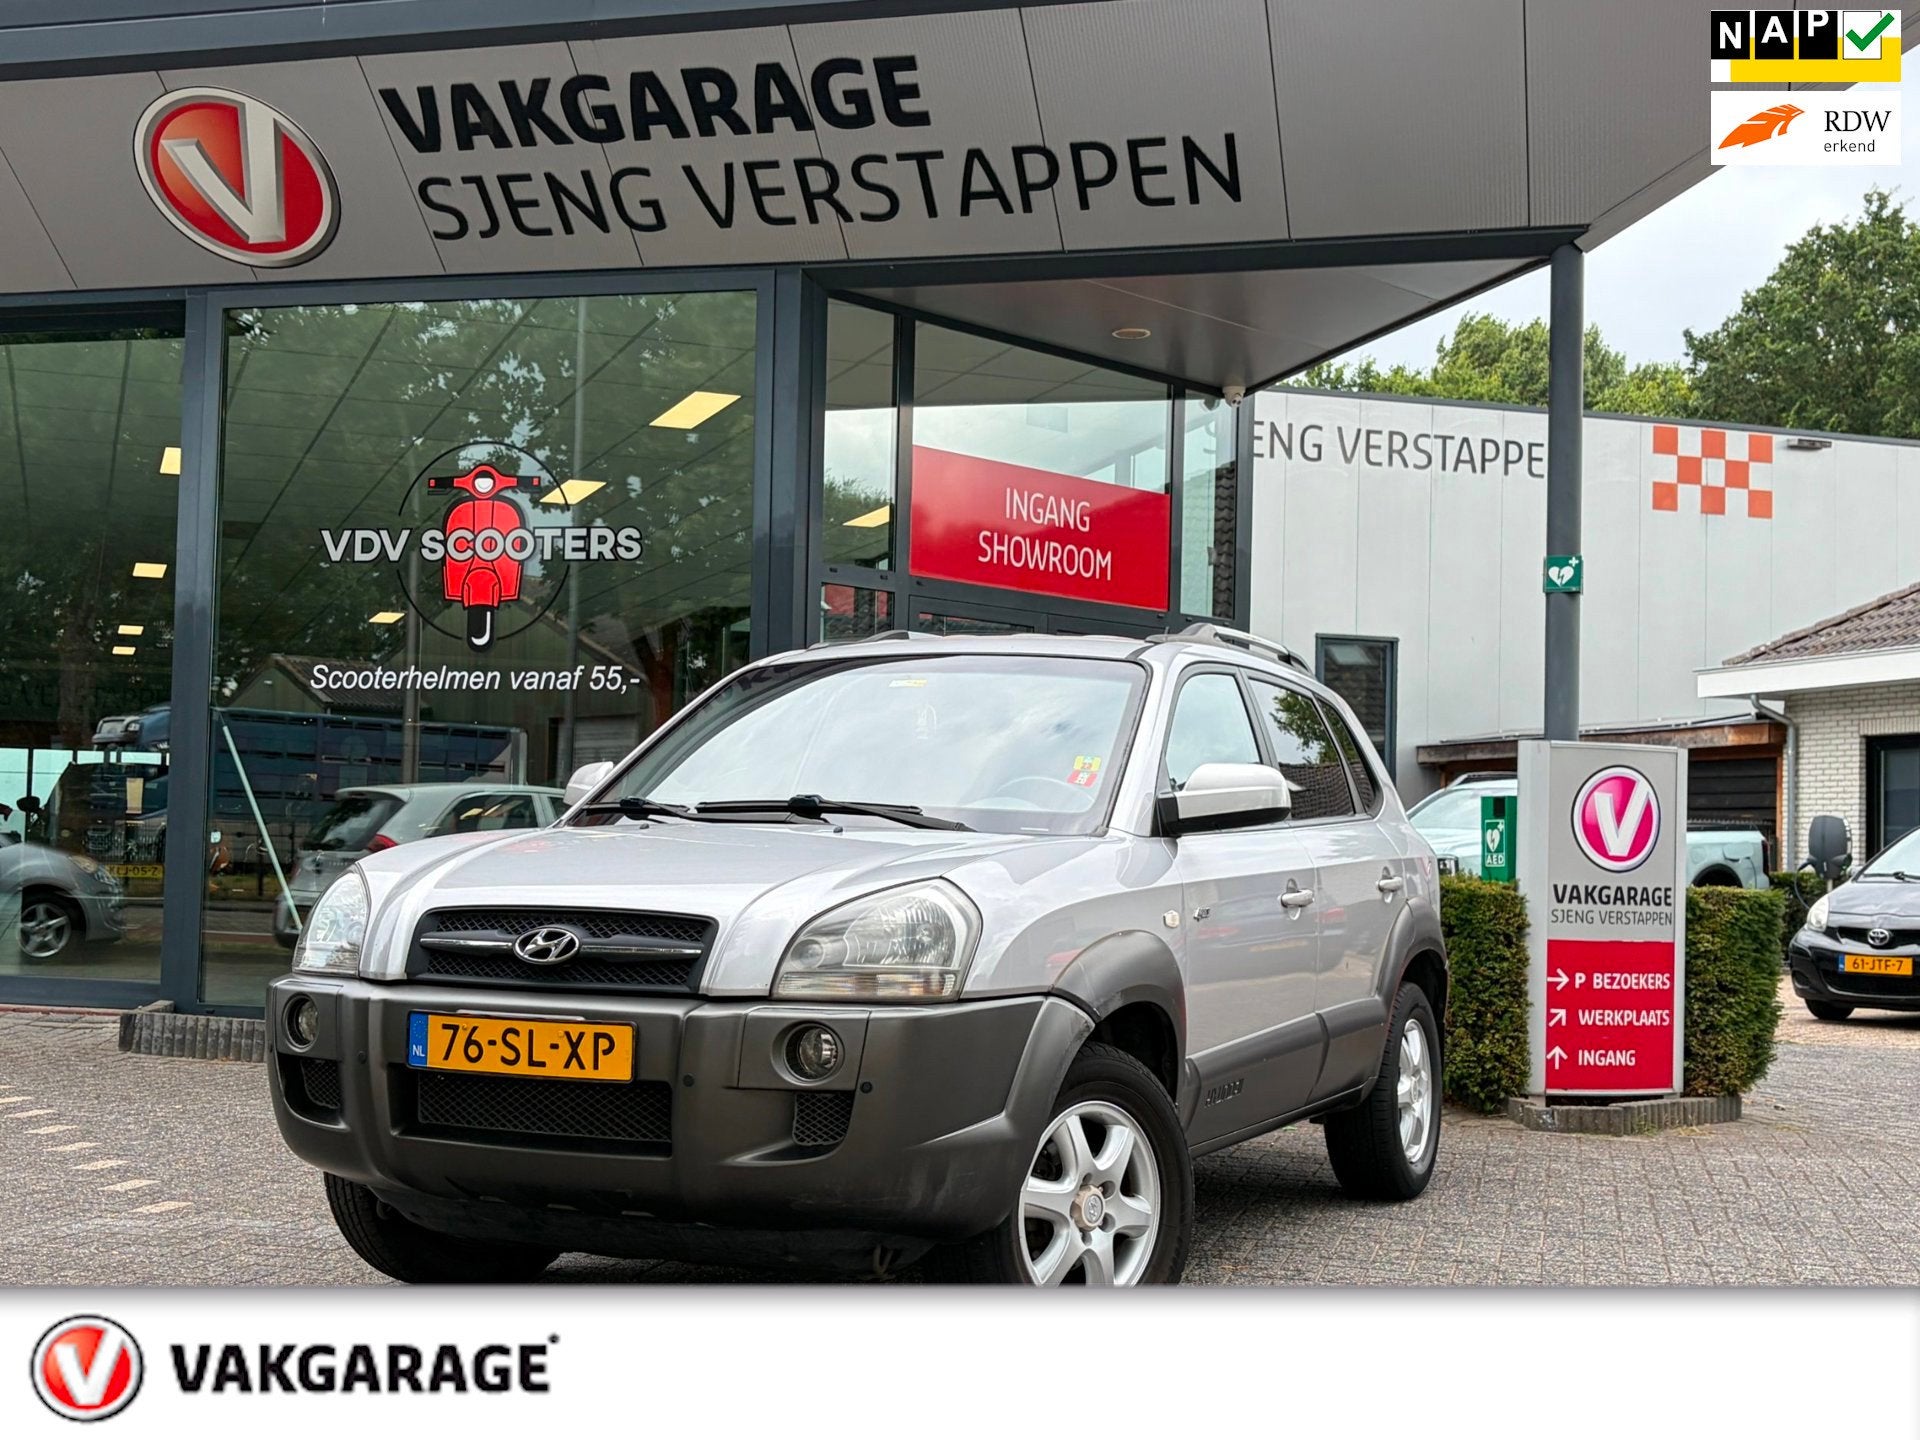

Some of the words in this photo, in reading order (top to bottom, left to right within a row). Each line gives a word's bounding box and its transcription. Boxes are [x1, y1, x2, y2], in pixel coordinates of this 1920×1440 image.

[378, 54, 931, 153] VAKGARAGE
[417, 166, 667, 241] SJENG
[682, 132, 1242, 229] VERSTAPPEN
[1337, 426, 1545, 479] VERSTAPPE
[1004, 487, 1091, 532] INGANG
[320, 528, 412, 562] VDV
[420, 527, 642, 561] SCOOTERS
[977, 530, 1112, 581] SHOWROOM
[309, 664, 500, 691] Scooterhelmen
[509, 664, 585, 690] vanaf
[589, 664, 640, 695] 55,-
[1487, 854, 1504, 865] AED
[1552, 884, 1673, 906] VAKGARAGE
[1550, 909, 1595, 925] SJENG
[1599, 909, 1673, 926] VERSTAPPEN
[1852, 958, 1904, 972] 61-JTF-7
[1574, 972, 1586, 989] P
[1593, 973, 1671, 990] BEZOEKERS
[1578, 1008, 1670, 1027] WERKPLAATS
[440, 1023, 616, 1071] 76-SL-XP
[1578, 1049, 1636, 1067] INGANG
